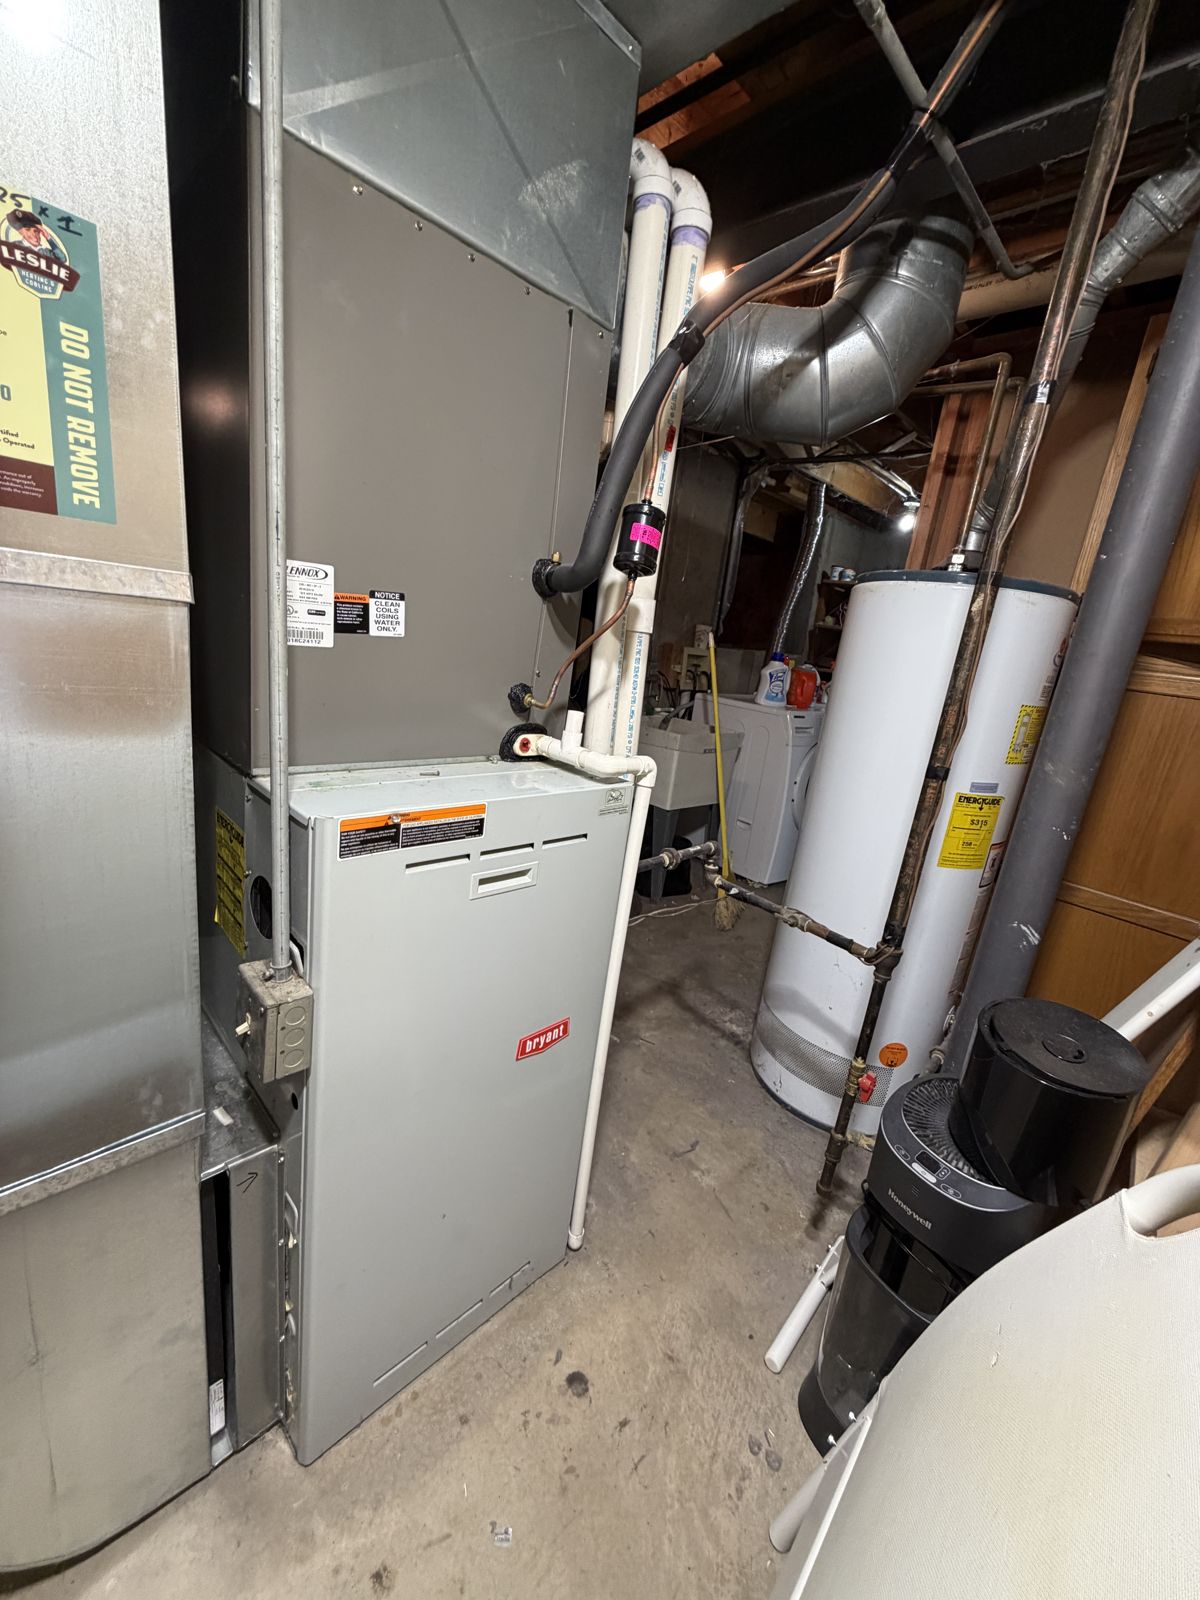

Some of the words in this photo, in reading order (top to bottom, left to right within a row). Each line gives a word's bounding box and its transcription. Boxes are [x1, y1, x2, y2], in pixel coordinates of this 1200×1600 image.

[1, 245, 70, 282] LESLIE
[21, 270, 48, 285] HEATING
[25, 279, 53, 293] COOLING
[59, 320, 91, 360] DO
[62, 362, 94, 414] NOT
[0, 429, 19, 438] tified
[3, 437, 35, 449] Operated
[66, 415, 100, 509] REMOVE
[339, 594, 366, 602] WARNING
[375, 591, 400, 600] NOTICE
[374, 600, 400, 608] CLEAN
[525, 1024, 564, 1053] bryant
[888, 1188, 932, 1230] Honeywell
